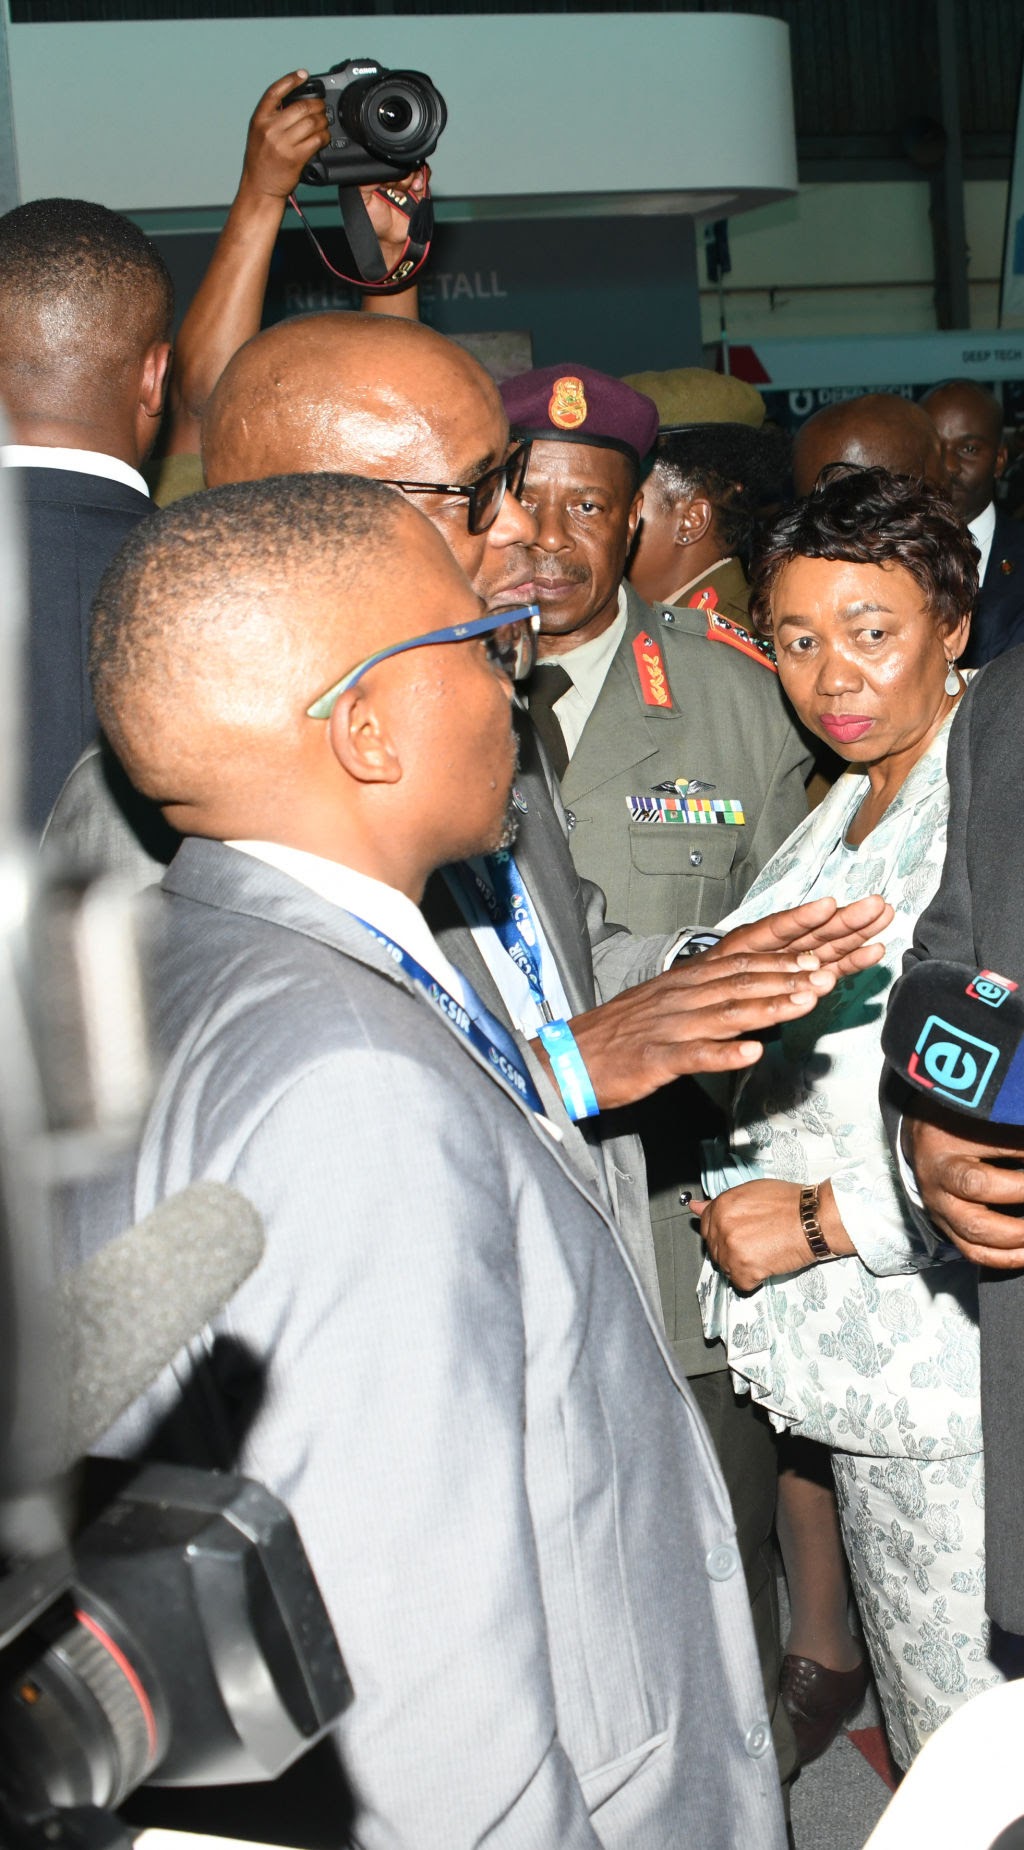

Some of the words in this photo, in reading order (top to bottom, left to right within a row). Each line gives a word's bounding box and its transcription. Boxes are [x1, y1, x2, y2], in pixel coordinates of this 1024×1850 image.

[352, 67, 377, 76] Canon
[962, 349, 991, 363] DEEP
[994, 348, 1021, 362] TECH
[439, 993, 471, 1034] CSIR
[499, 1056, 528, 1095] CSIR
[924, 1041, 978, 1091] e
